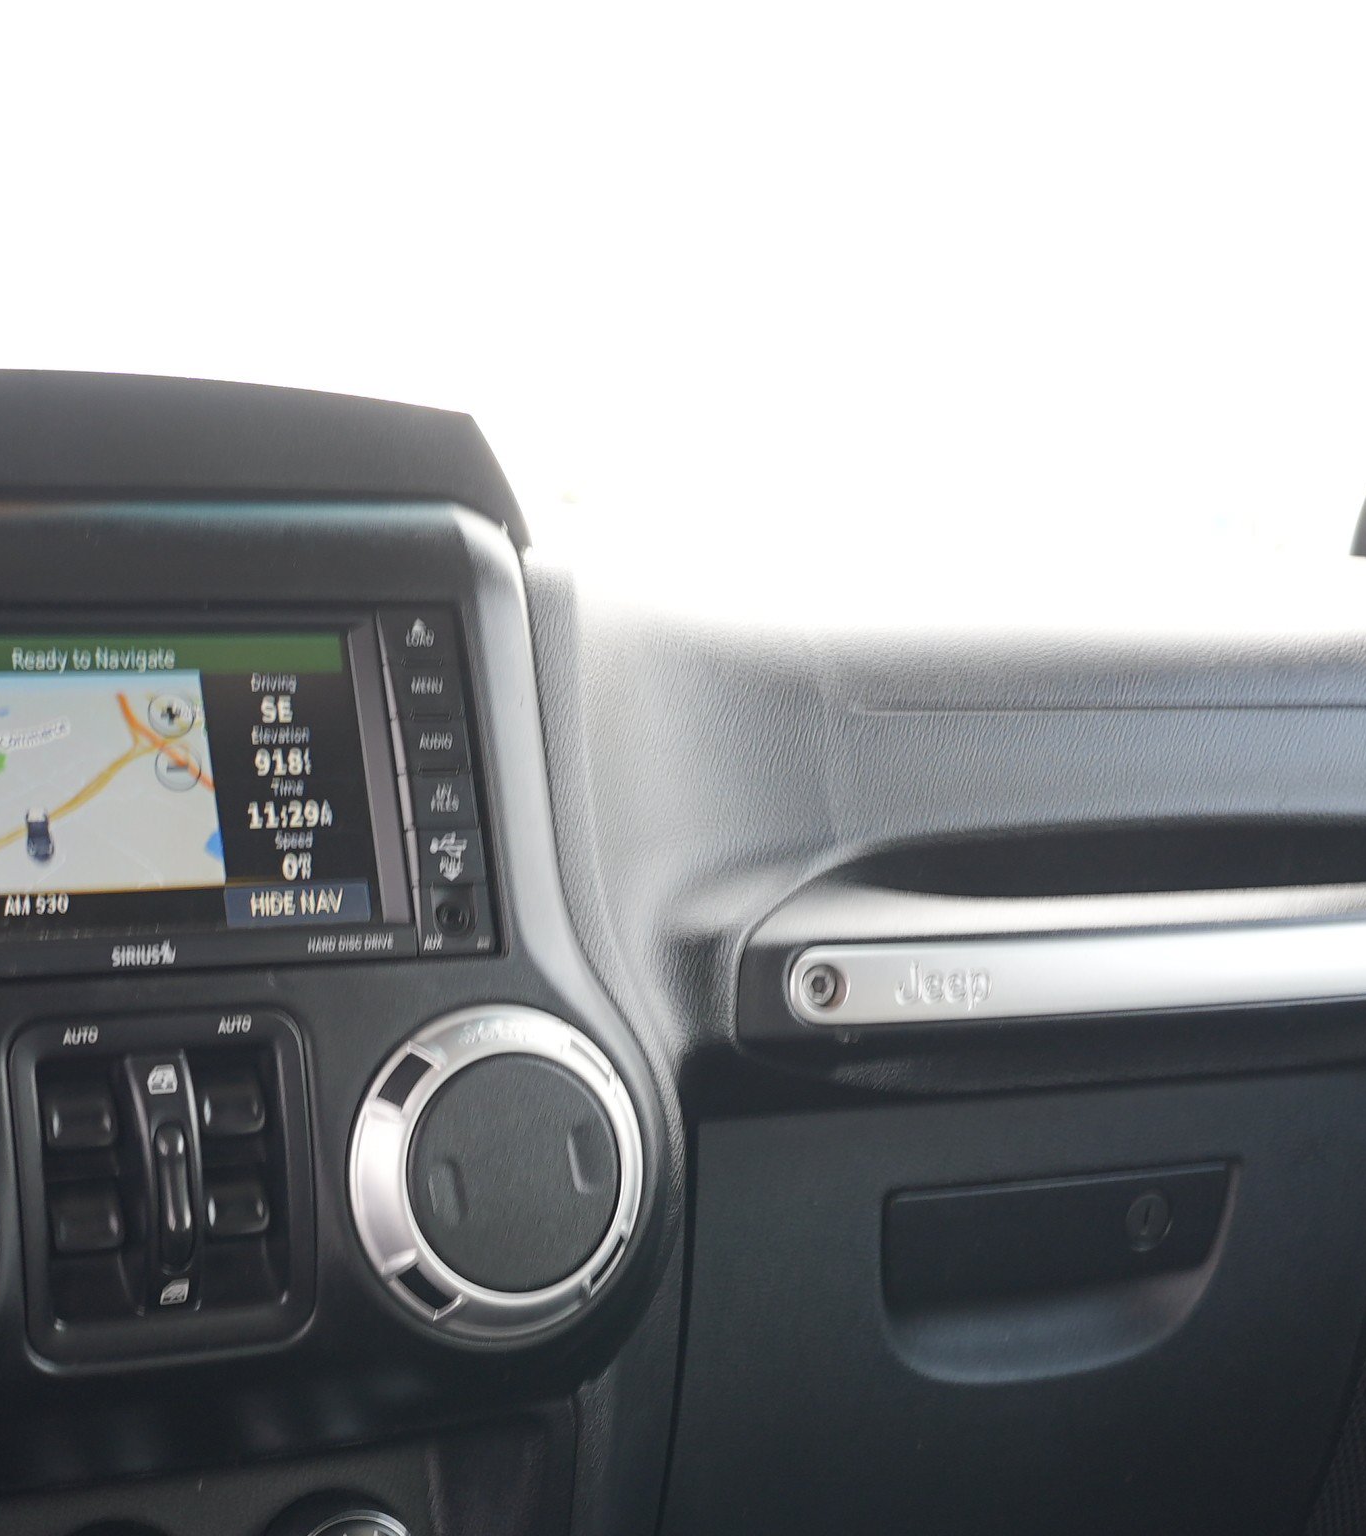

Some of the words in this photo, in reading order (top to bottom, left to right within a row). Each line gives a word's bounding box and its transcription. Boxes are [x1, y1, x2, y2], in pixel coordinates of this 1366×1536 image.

[405, 629, 435, 648] LOAD
[12, 646, 68, 674] Ready
[72, 647, 91, 670] to
[95, 645, 176, 673] Navigate
[251, 672, 298, 695] Driving
[410, 676, 444, 695] MENU
[261, 695, 294, 724] SE
[251, 725, 310, 746] Elevation
[419, 731, 453, 751] AUDIO
[271, 778, 304, 797] Time
[275, 831, 314, 851] Speed
[4, 893, 31, 917] AM
[250, 889, 296, 918] HIDE
[300, 887, 344, 915] NAV
[308, 935, 336, 954] HARD
[364, 932, 394, 951] DRIVE
[424, 933, 444, 951] AUX
[895, 959, 993, 1012] Jeep
[218, 1013, 252, 1035] AUTO
[63, 1025, 98, 1046] AUTO
